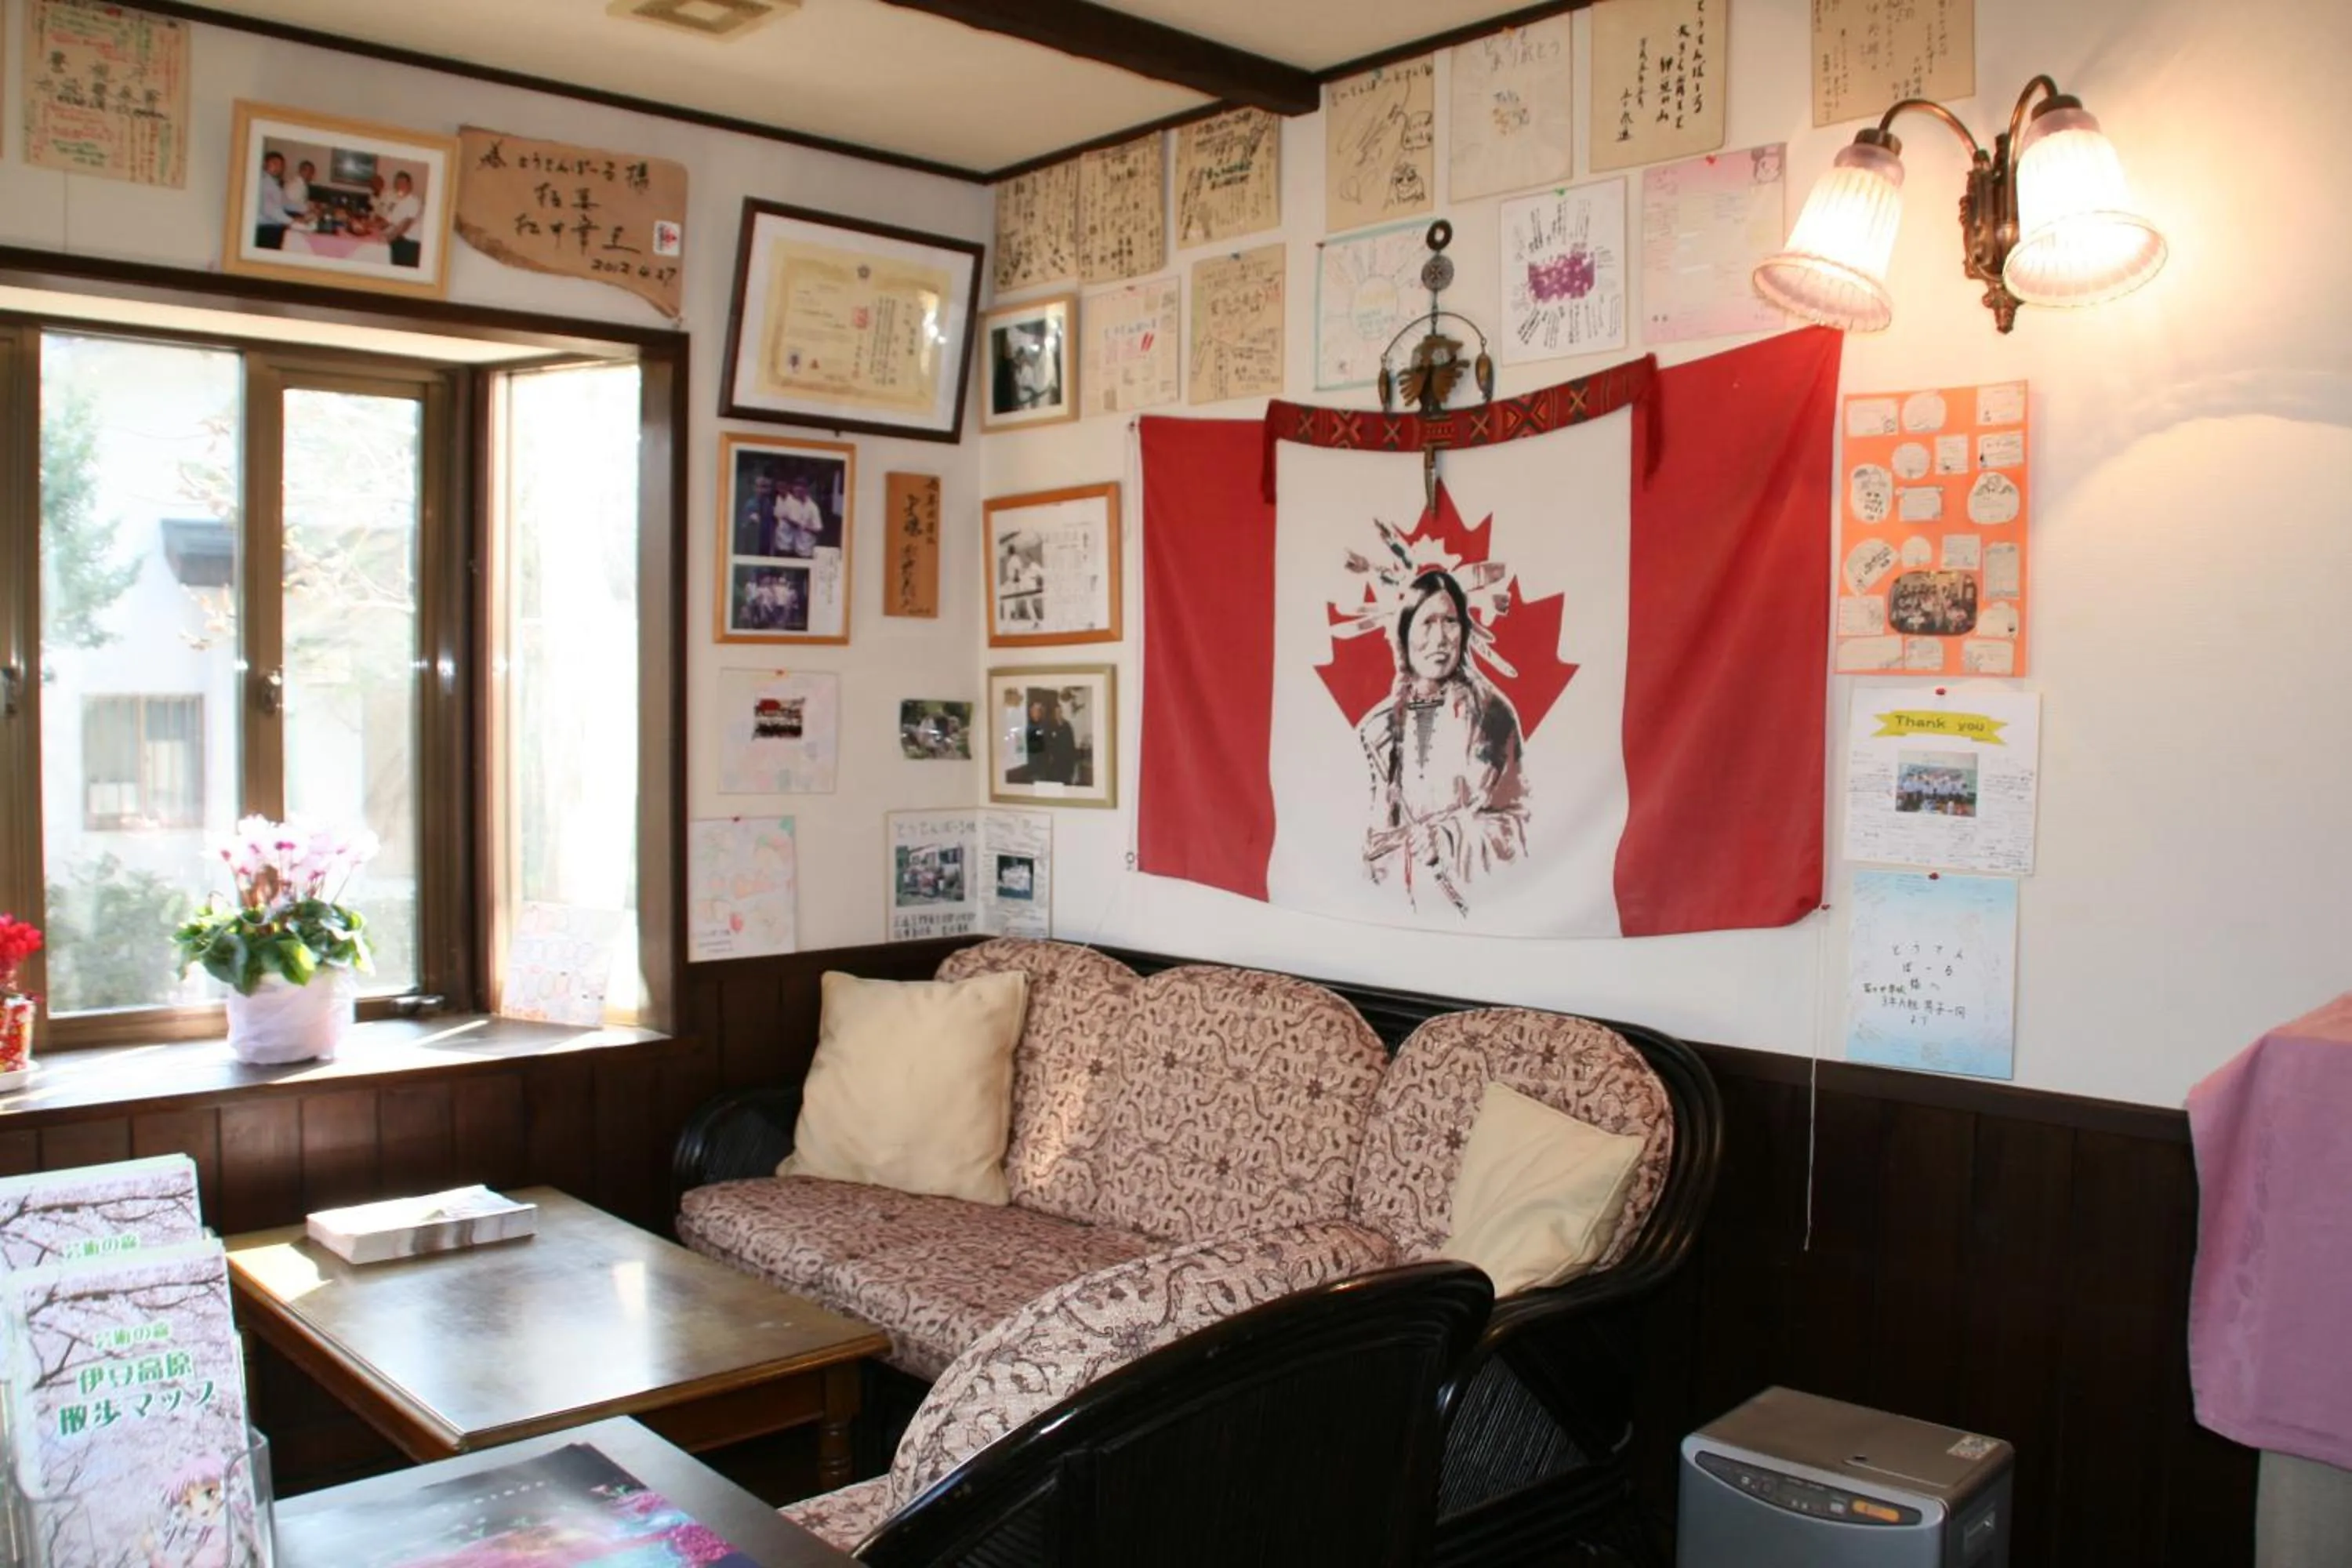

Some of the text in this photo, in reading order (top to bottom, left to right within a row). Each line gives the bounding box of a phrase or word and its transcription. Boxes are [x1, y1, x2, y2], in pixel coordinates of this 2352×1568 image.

[1895, 714, 1986, 732] Thank you
[78, 1350, 193, 1395] 伊豆高原
[59, 1380, 216, 1437] 散歩マップ
